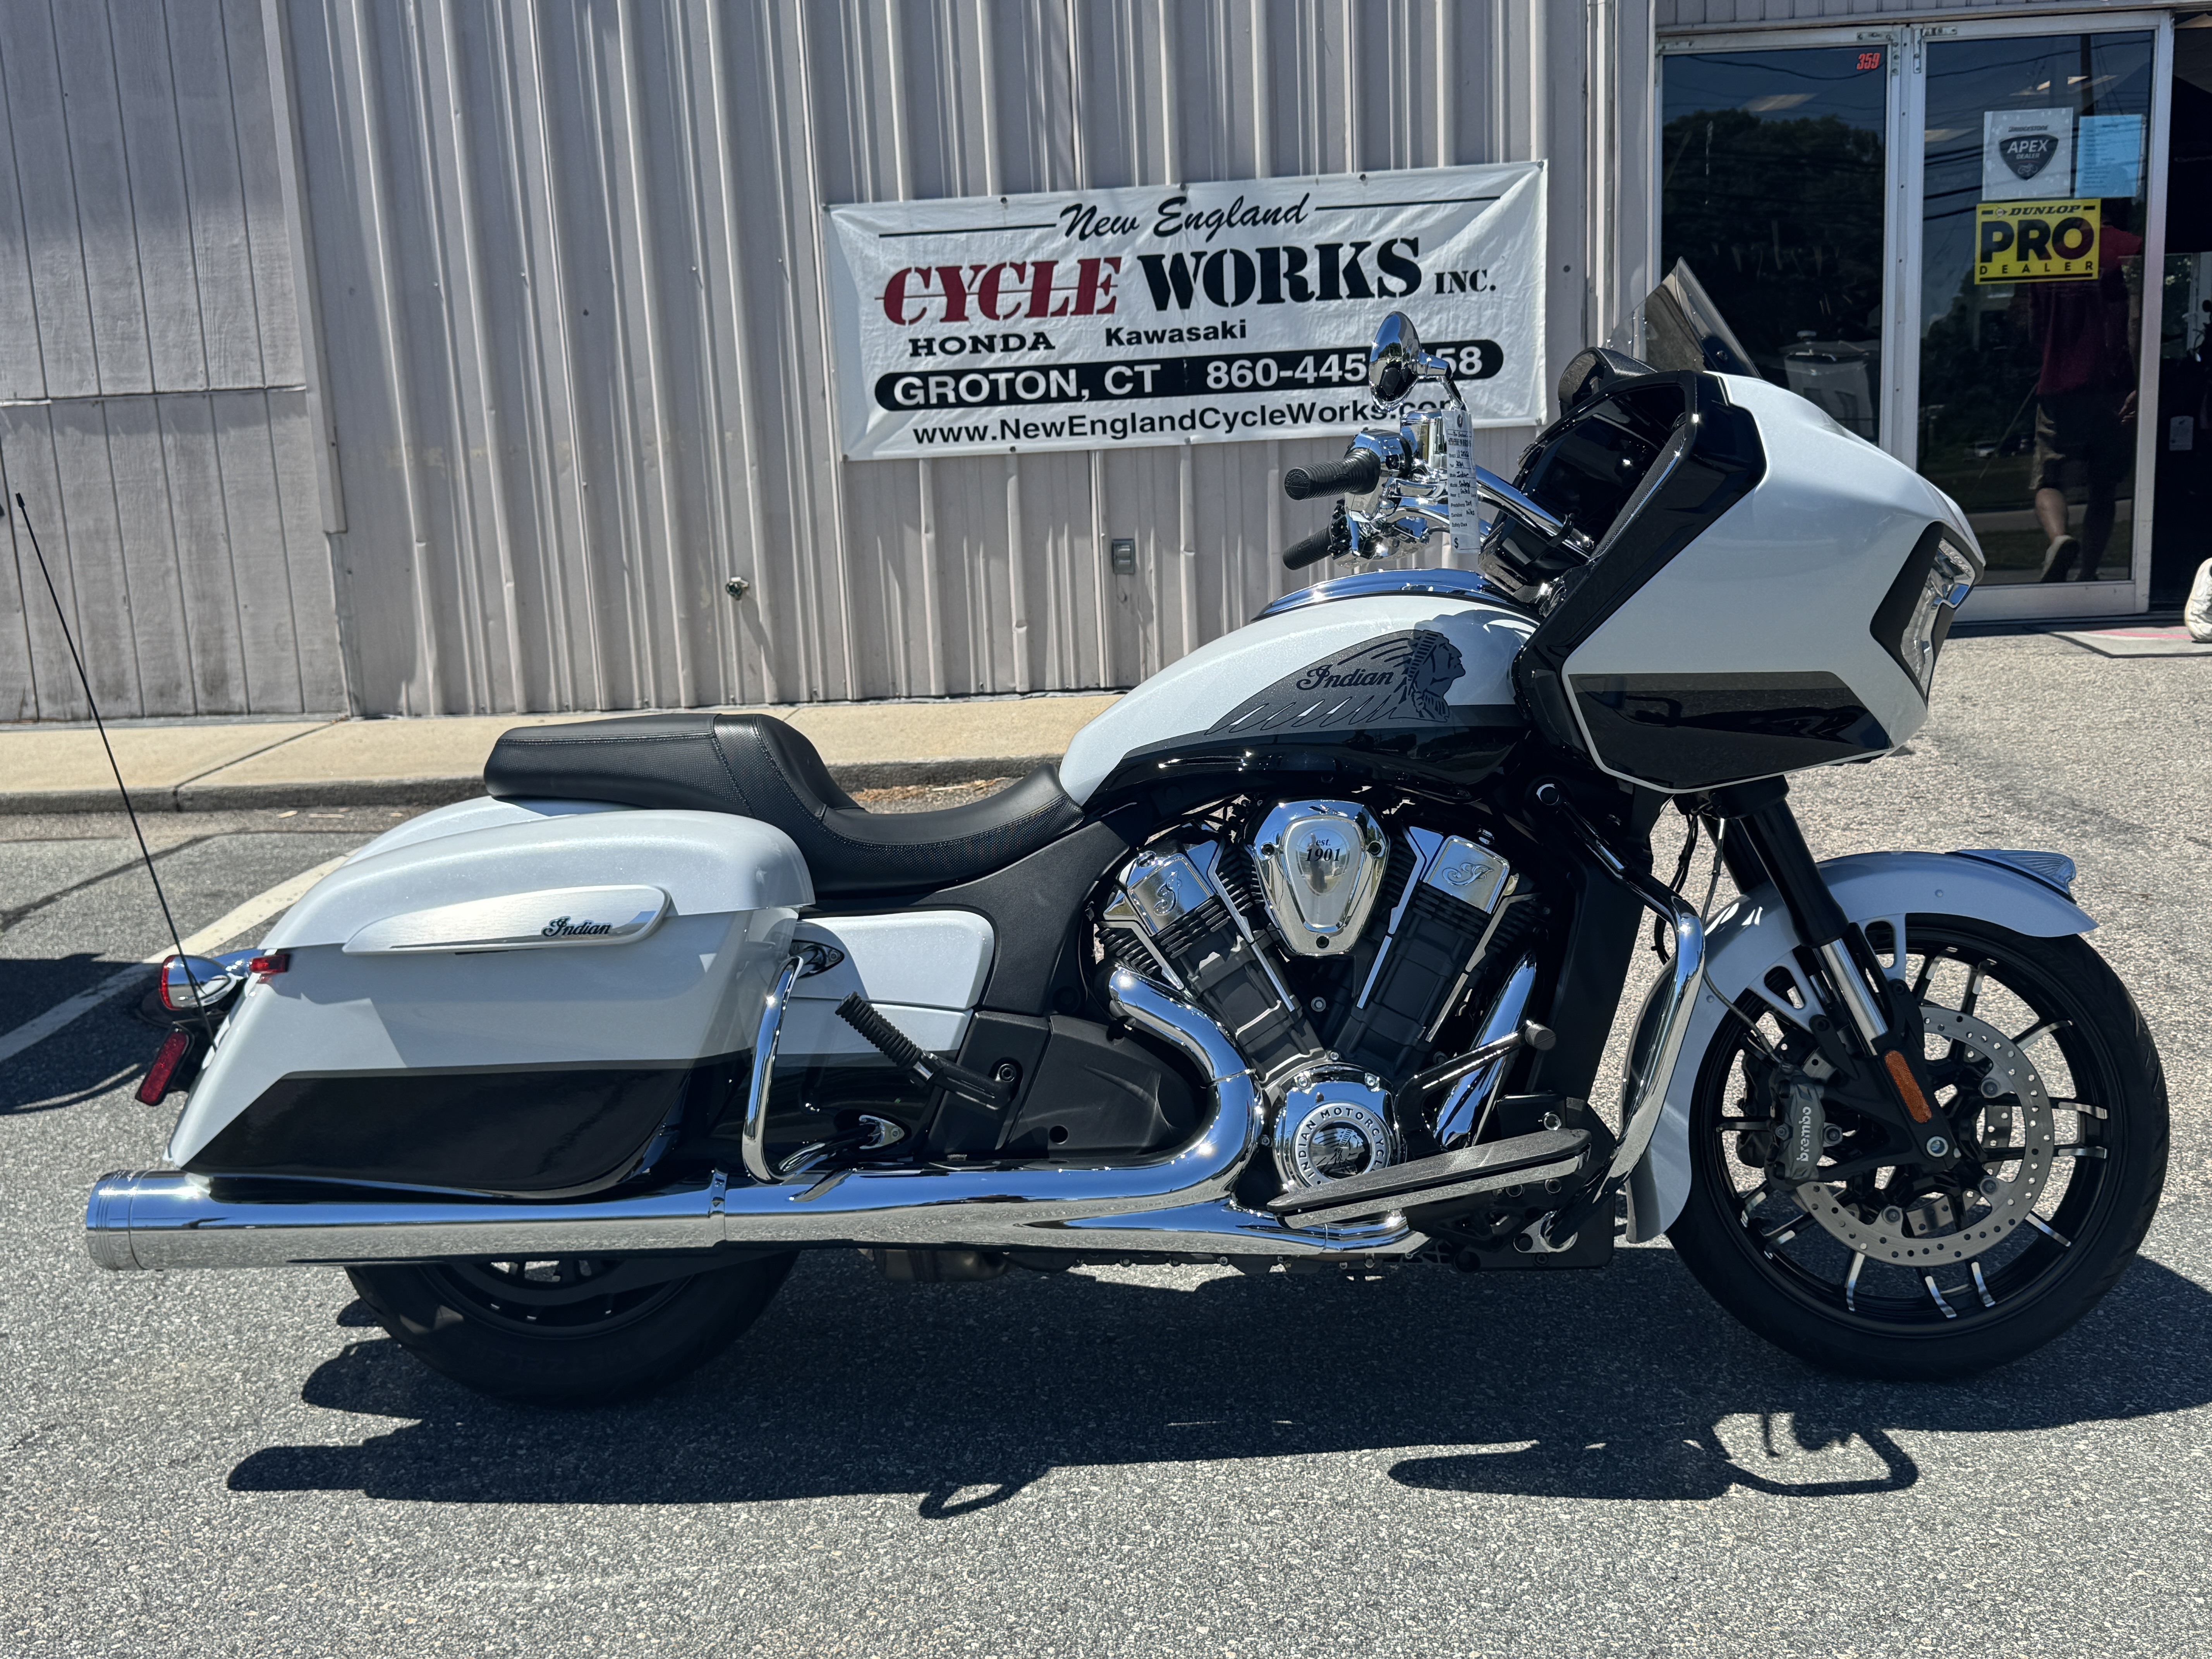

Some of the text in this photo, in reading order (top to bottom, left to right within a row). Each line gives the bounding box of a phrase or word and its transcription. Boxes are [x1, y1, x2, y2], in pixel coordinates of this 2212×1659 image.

[1856, 53, 1881, 70] 359
[2007, 139, 2050, 154] APEX
[1060, 192, 1310, 243] New England
[2009, 205, 2081, 216] DUNLOP
[1980, 216, 2094, 263] PRO
[1980, 261, 2093, 275] DEALER
[883, 237, 1496, 326] CYCLE WORKS INC.
[908, 332, 1056, 357] HONDA
[1106, 319, 1246, 347] Kawasaki
[894, 368, 1089, 406] GROTON,
[1104, 363, 1161, 395] CT
[1296, 665, 1395, 690] Indian
[1316, 838, 1331, 846] est.
[1305, 848, 1341, 862] 1901
[543, 916, 611, 937] Indian
[1298, 1107, 1385, 1179] INDIAN MOTORCYCL
[1796, 1106, 1812, 1161] brembo
